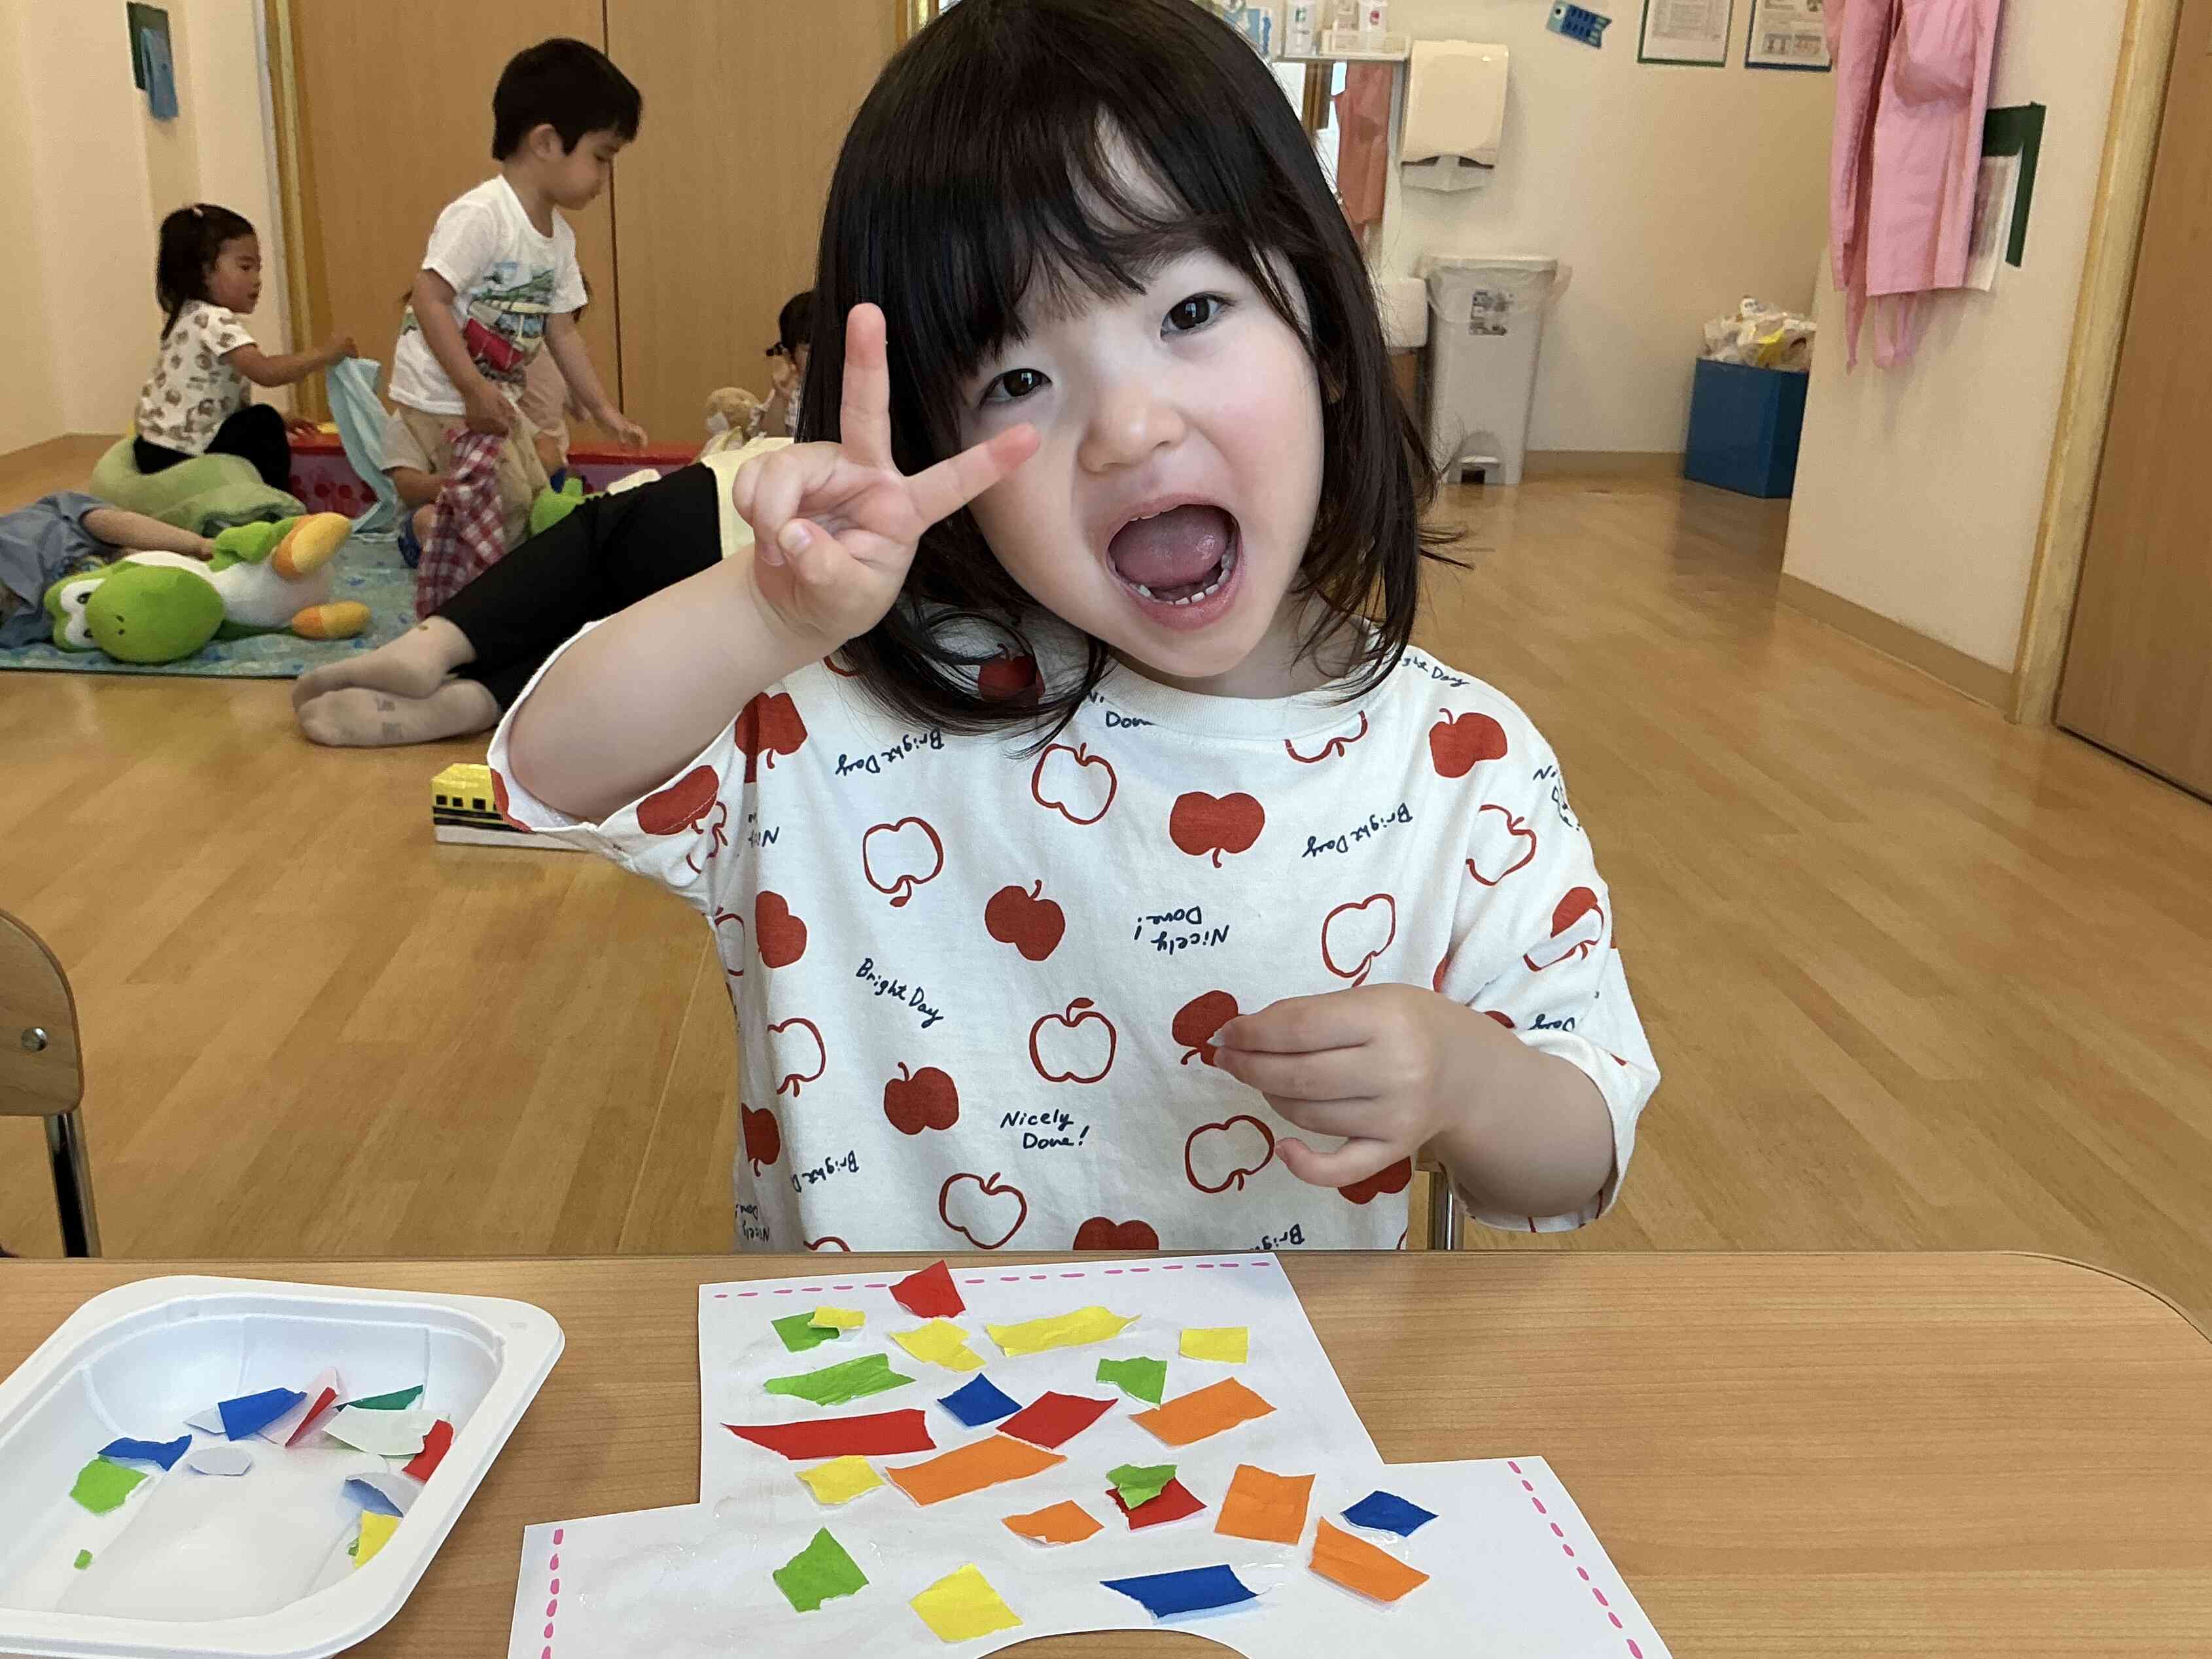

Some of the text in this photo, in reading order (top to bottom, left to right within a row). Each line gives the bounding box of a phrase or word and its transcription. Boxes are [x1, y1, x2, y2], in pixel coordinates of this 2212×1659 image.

[1431, 665, 1471, 688] Day
[835, 727, 945, 777] Bright Day
[1301, 802, 1414, 858] Bright Day
[1134, 905, 1203, 941] Done!
[1150, 924, 1230, 956] Nicely
[855, 957, 945, 1029] Bright Day
[1526, 1013, 1575, 1032] Day
[1000, 1108, 1075, 1132] Nicely
[1023, 1125, 1090, 1150] Done!
[801, 1149, 860, 1185] Bright
[1250, 1223, 1306, 1251] Brig
